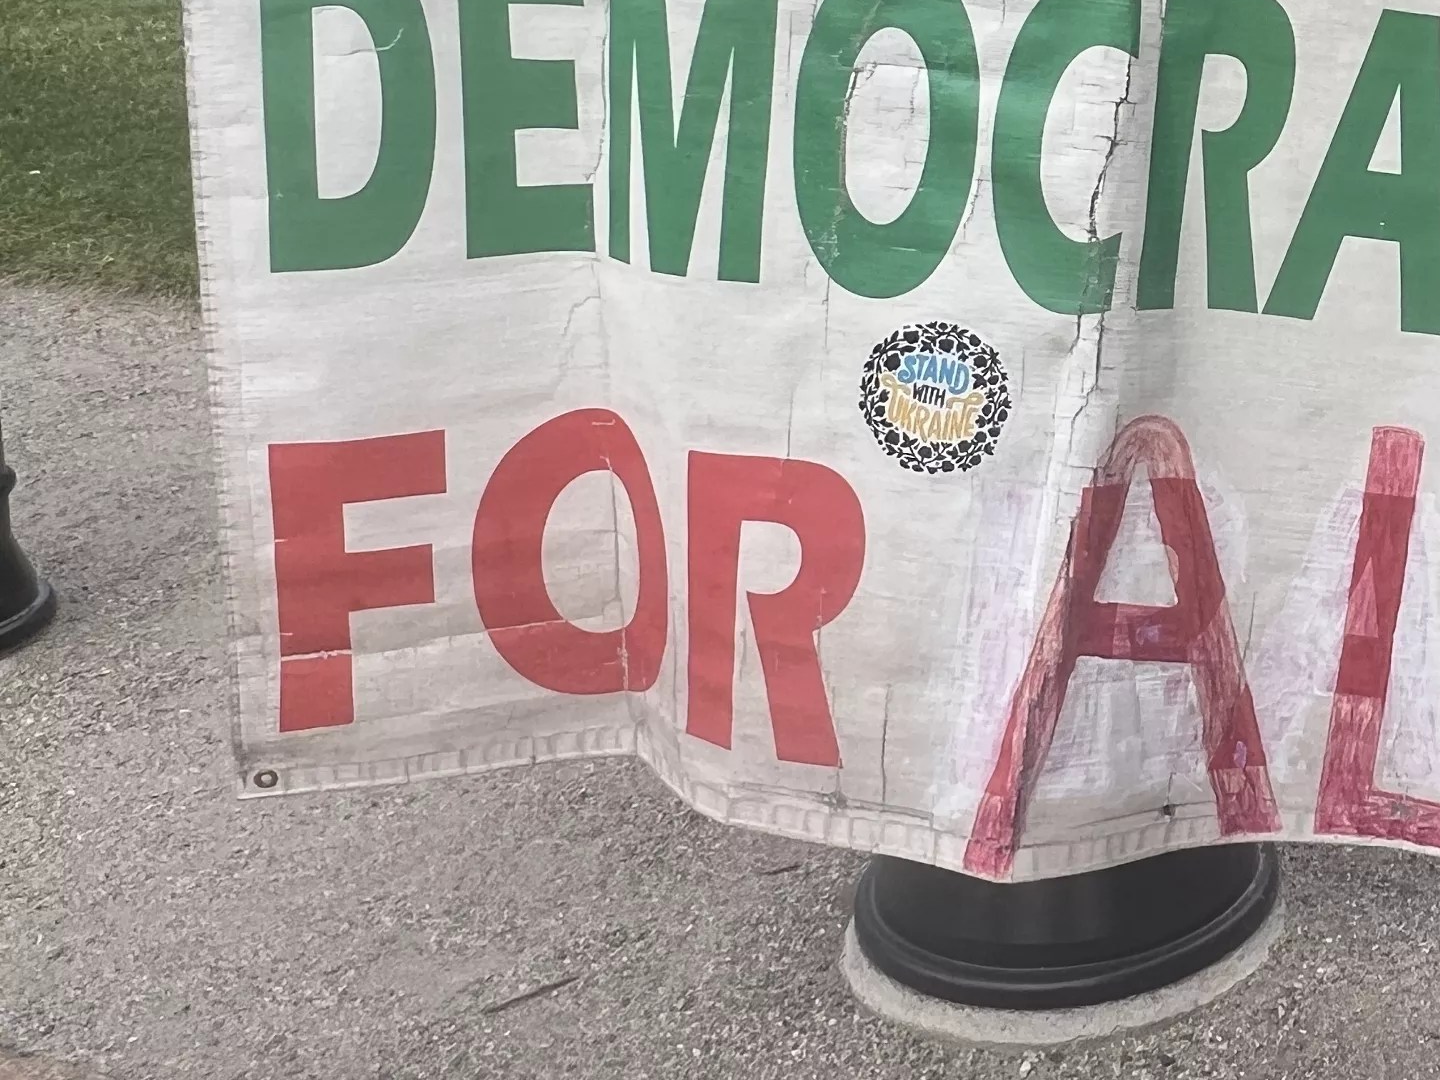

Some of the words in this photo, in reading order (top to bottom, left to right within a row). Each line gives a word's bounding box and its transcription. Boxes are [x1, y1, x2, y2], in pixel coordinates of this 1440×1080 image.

[897, 354, 970, 395] STAND
[913, 383, 946, 408] WITH
[881, 373, 984, 443] UKRAINE
[268, 408, 866, 767] FOR
